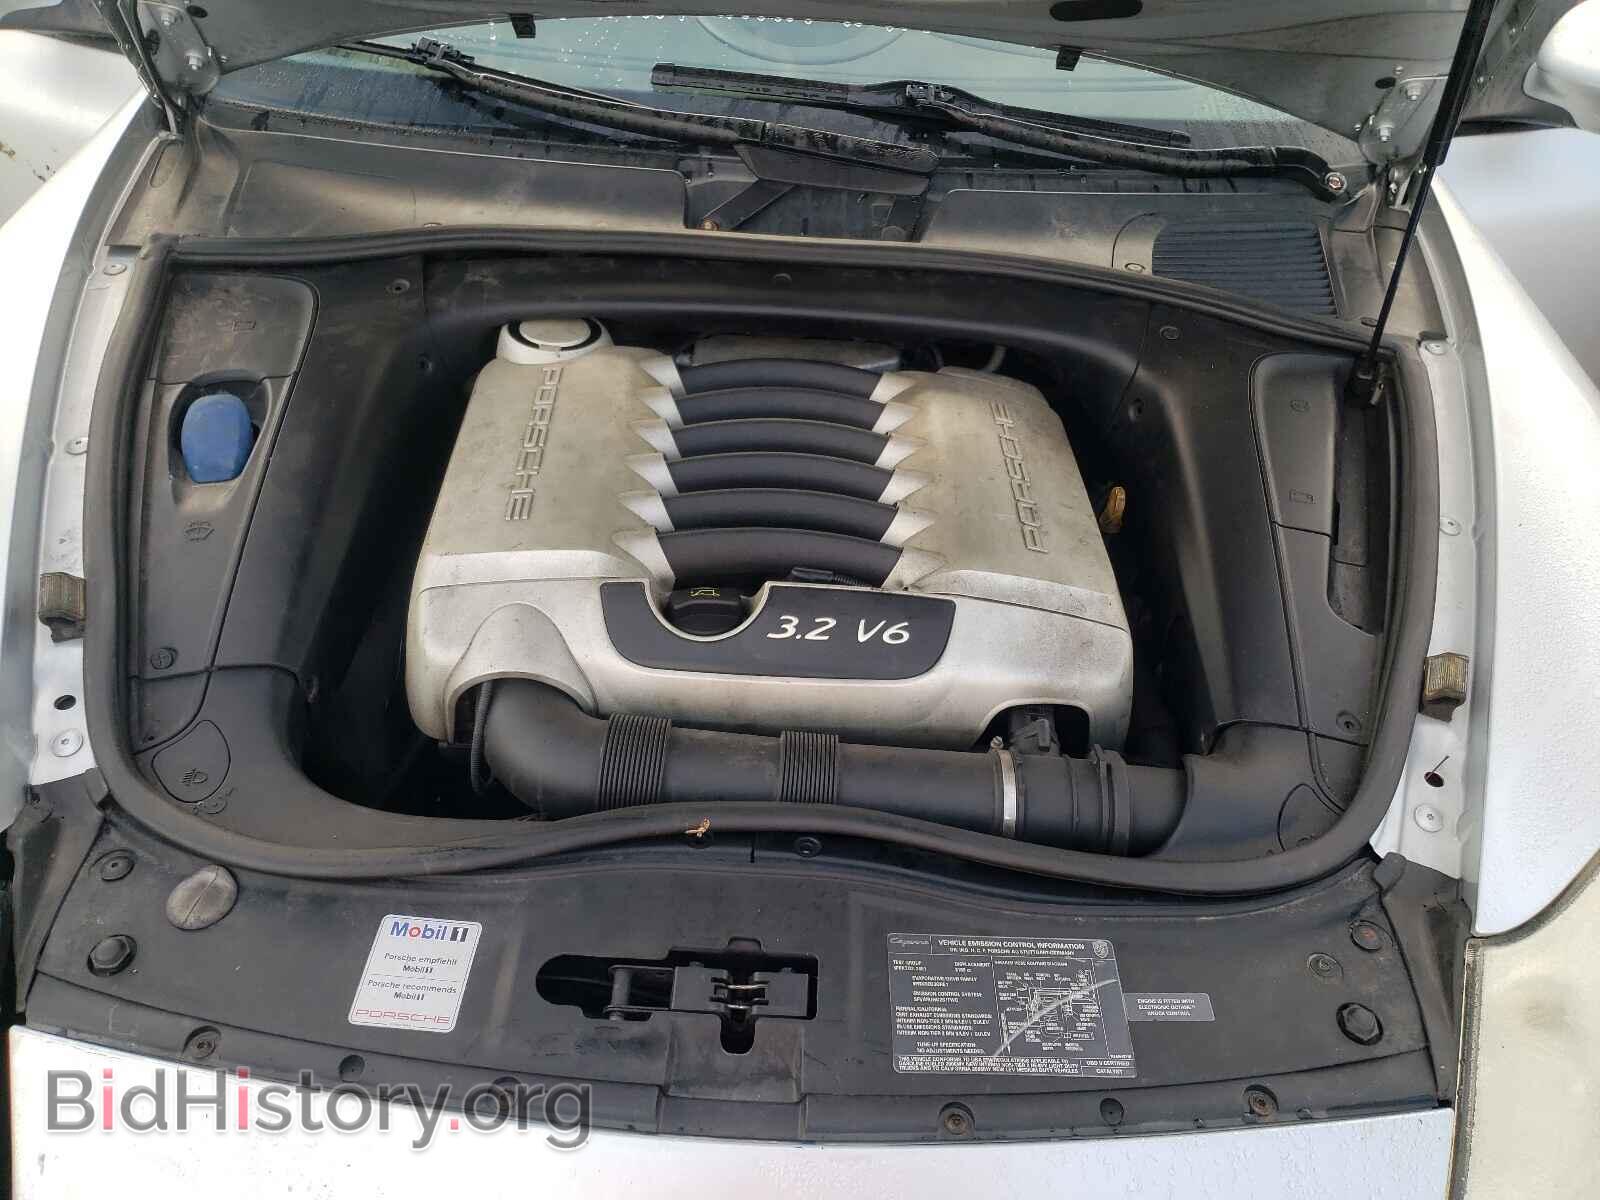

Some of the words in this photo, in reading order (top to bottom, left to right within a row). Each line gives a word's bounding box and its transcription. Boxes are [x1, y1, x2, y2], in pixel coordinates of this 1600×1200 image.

[504, 367, 563, 521] PORSCHE
[989, 400, 1048, 553] PORSCHE
[766, 615, 837, 641] 3.2
[857, 618, 910, 644] V6
[390, 921, 448, 941] Mobil
[938, 939, 966, 947] VEHICLE
[967, 940, 1002, 948] EMISSION
[1003, 941, 1035, 949] CONTROL
[1036, 942, 1085, 950] INFORMATION
[384, 952, 417, 962] Porsche
[419, 956, 458, 966] empfiehlt
[368, 979, 401, 989] Porsche
[402, 982, 457, 994] recommends
[355, 1009, 450, 1024] PORSCHE
